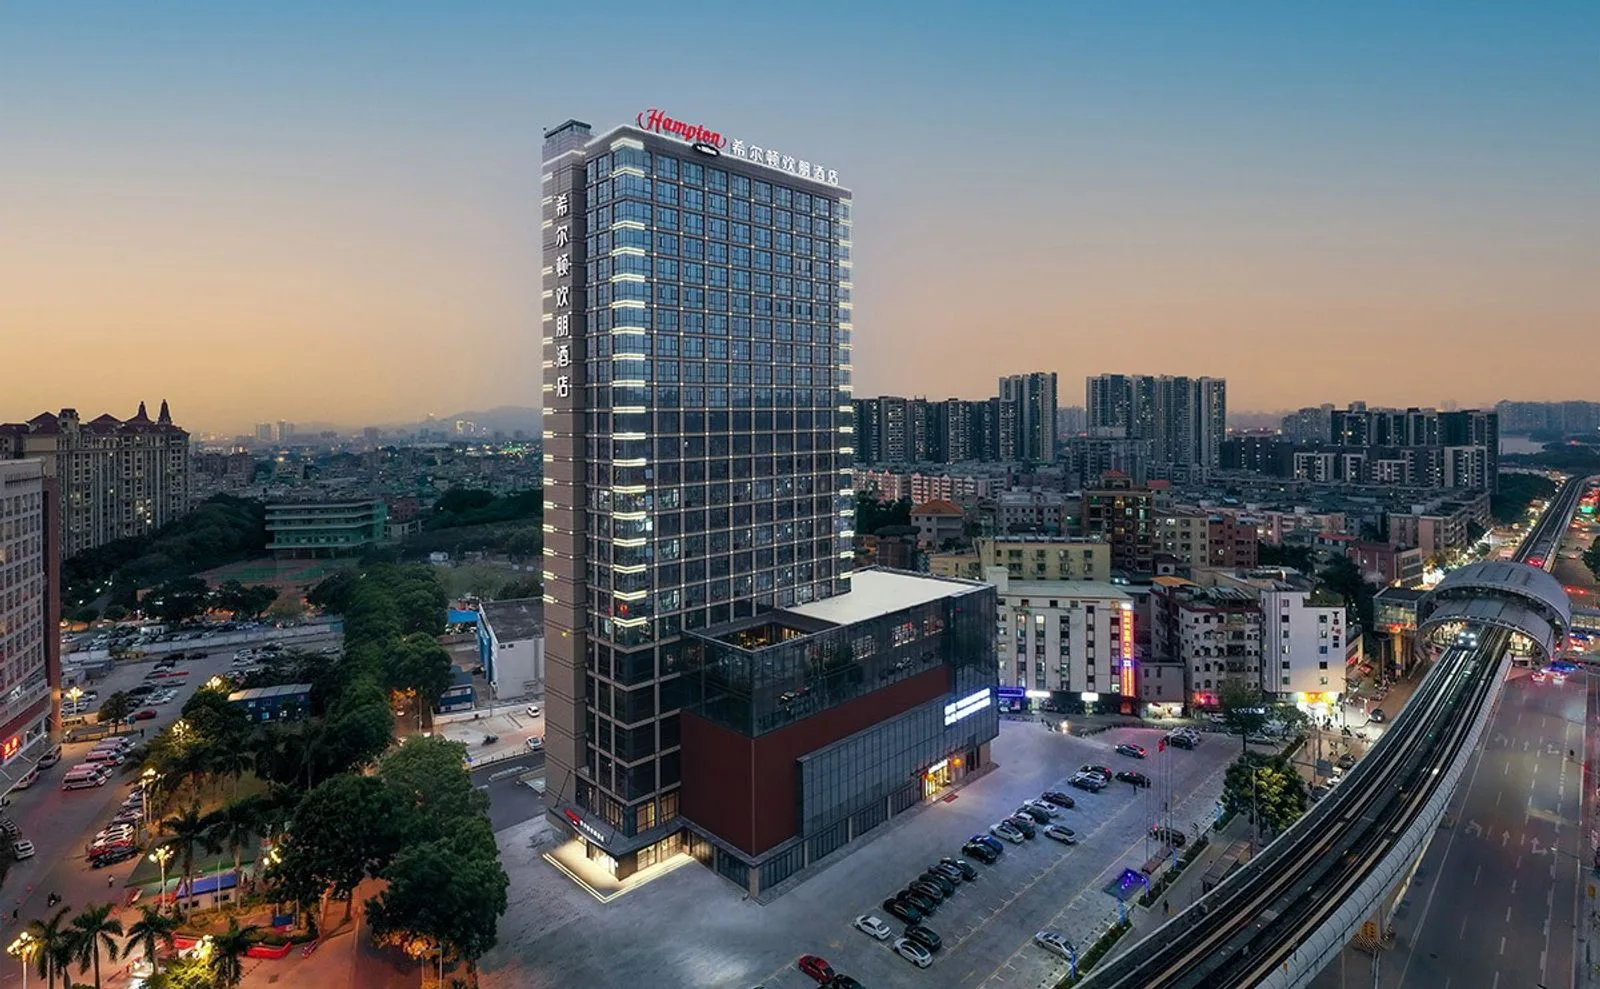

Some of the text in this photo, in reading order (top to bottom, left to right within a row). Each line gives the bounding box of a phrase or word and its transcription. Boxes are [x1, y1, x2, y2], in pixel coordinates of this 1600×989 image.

[638, 108, 727, 149] Hampton
[731, 138, 840, 186] 希尔顿欢朋酒店
[555, 193, 570, 398] 希尔顿欢朋酒店
